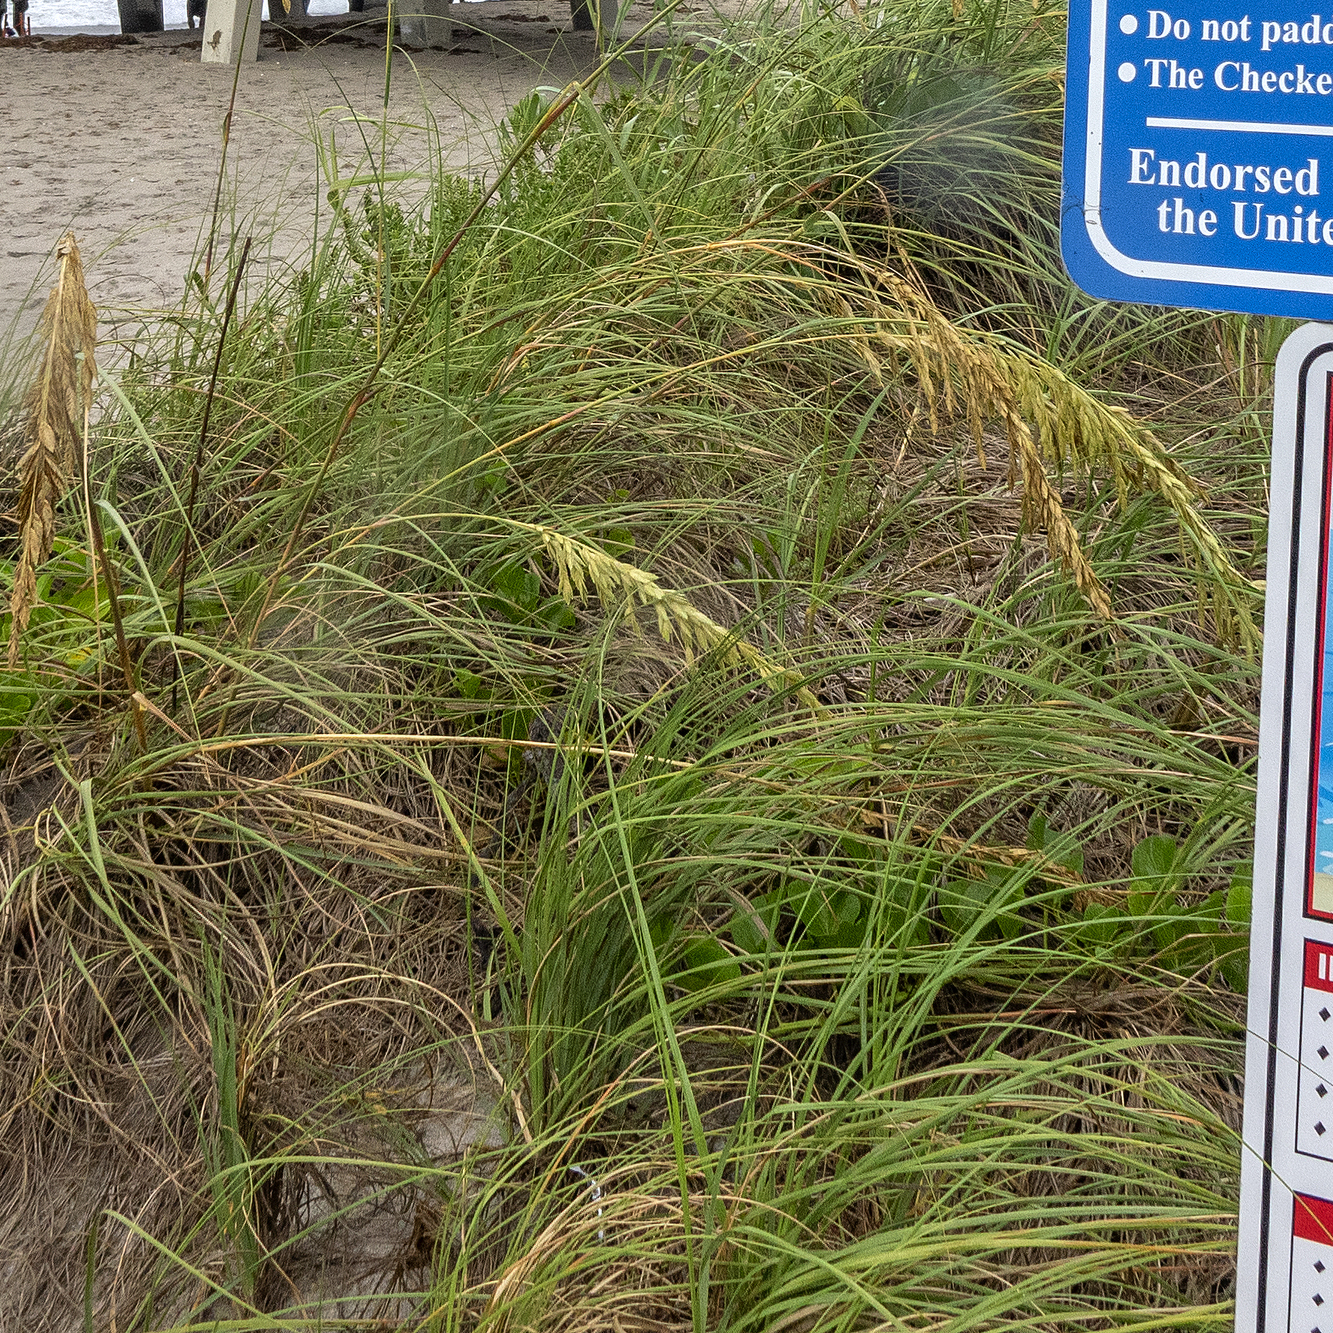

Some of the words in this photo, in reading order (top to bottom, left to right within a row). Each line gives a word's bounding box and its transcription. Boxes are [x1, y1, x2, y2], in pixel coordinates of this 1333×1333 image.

[1146, 10, 1191, 40] Do
[1201, 14, 1252, 42] not
[1144, 58, 1204, 90] The
[1127, 148, 1320, 196] Endorsed
[1156, 197, 1218, 236] the
